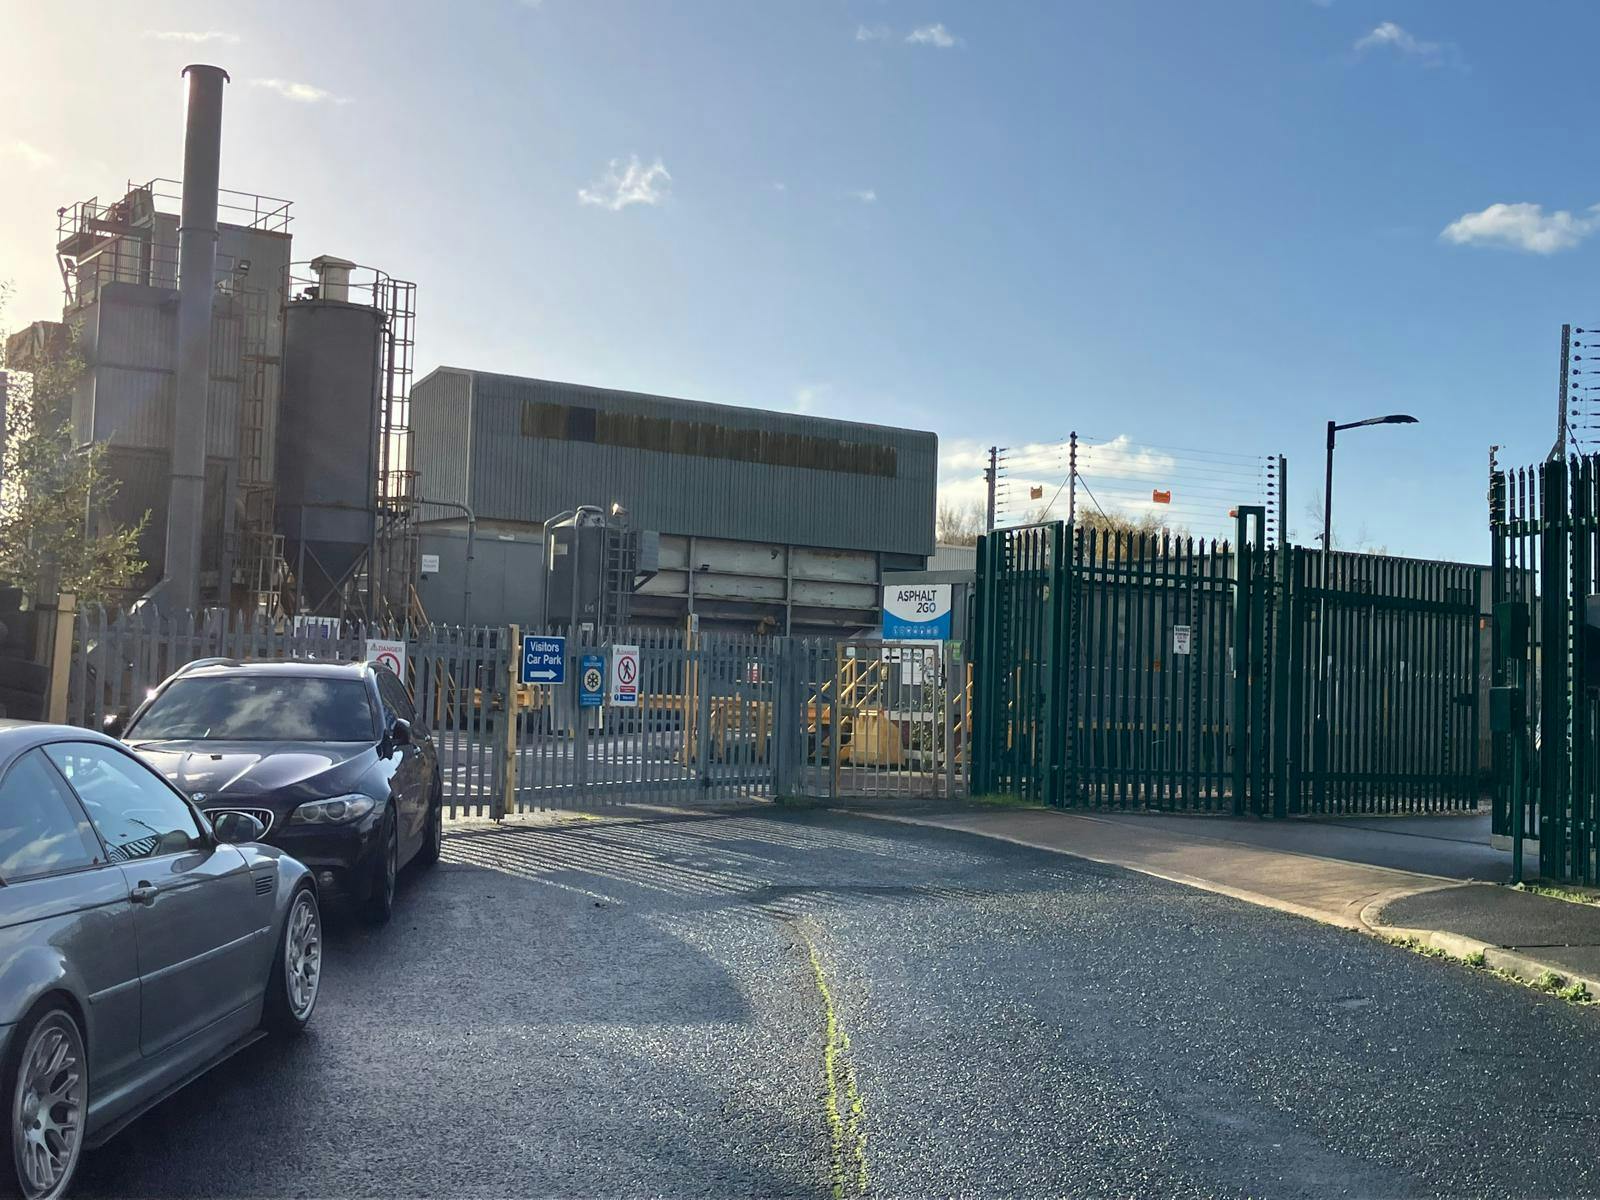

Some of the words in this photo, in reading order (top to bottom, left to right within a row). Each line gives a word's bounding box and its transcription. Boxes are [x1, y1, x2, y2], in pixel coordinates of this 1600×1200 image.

[897, 590, 937, 602] ASPHALT
[916, 602, 936, 613] 2GO
[530, 641, 560, 653] Visitors
[527, 653, 541, 665] Car
[543, 654, 562, 665] Park
